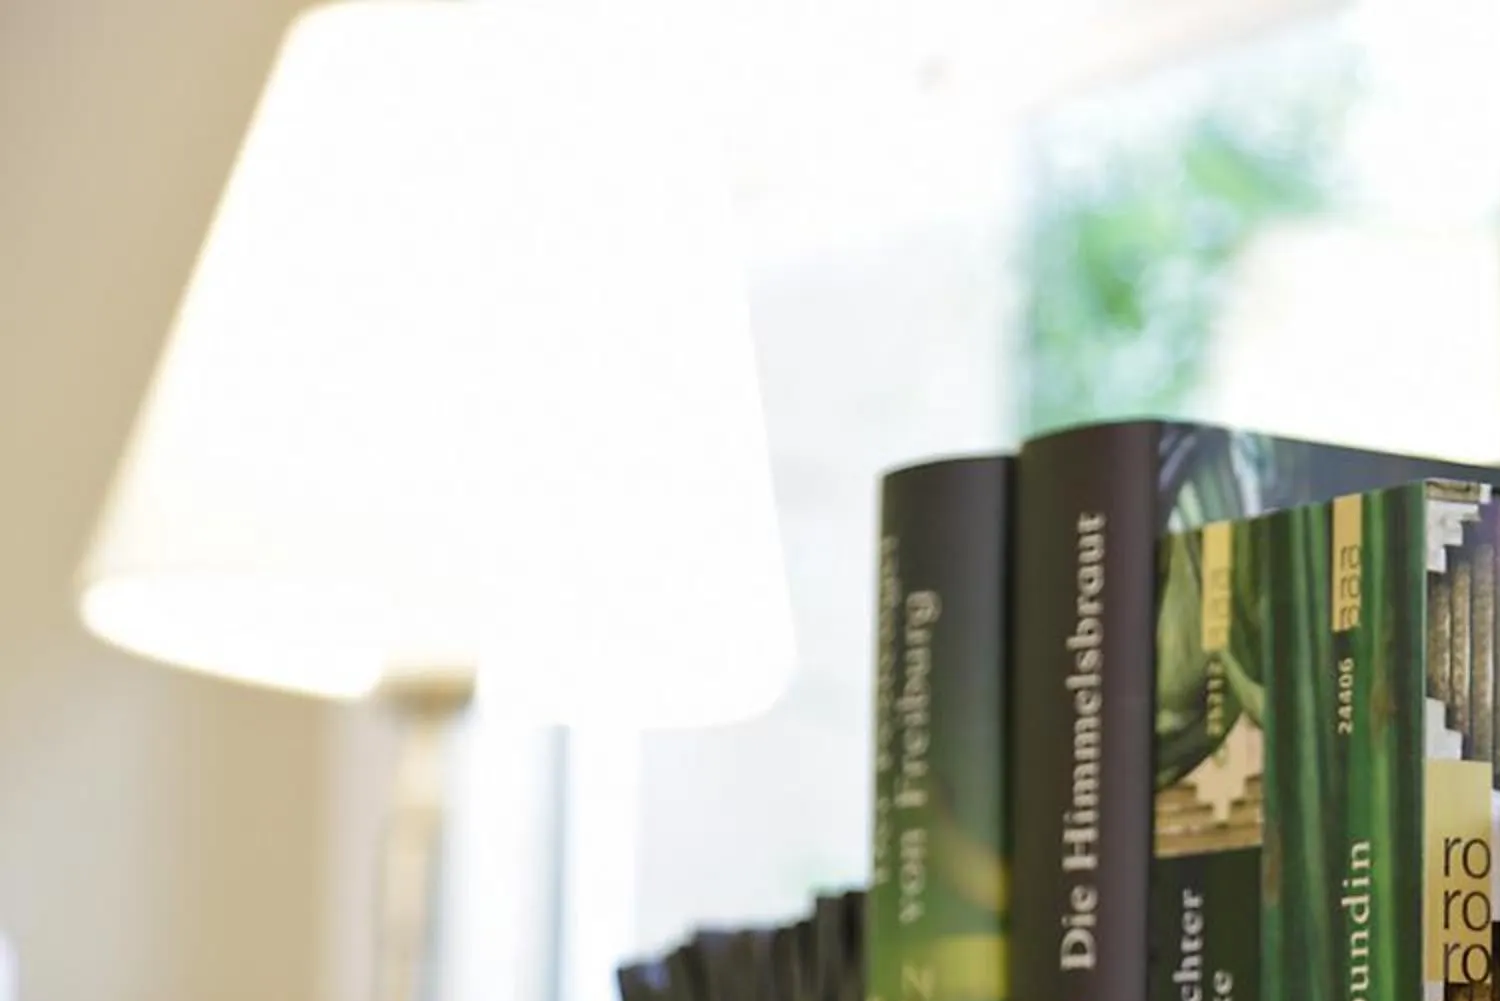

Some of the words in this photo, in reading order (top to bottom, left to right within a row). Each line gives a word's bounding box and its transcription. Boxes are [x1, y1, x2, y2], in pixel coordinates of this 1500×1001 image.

[1062, 511, 1107, 872] Himmelsbraut
[1338, 657, 1354, 735] 24406
[1443, 837, 1491, 879] ro
[1060, 884, 1098, 972] Die
[1443, 888, 1491, 931] ro
[1443, 939, 1491, 983] ro
